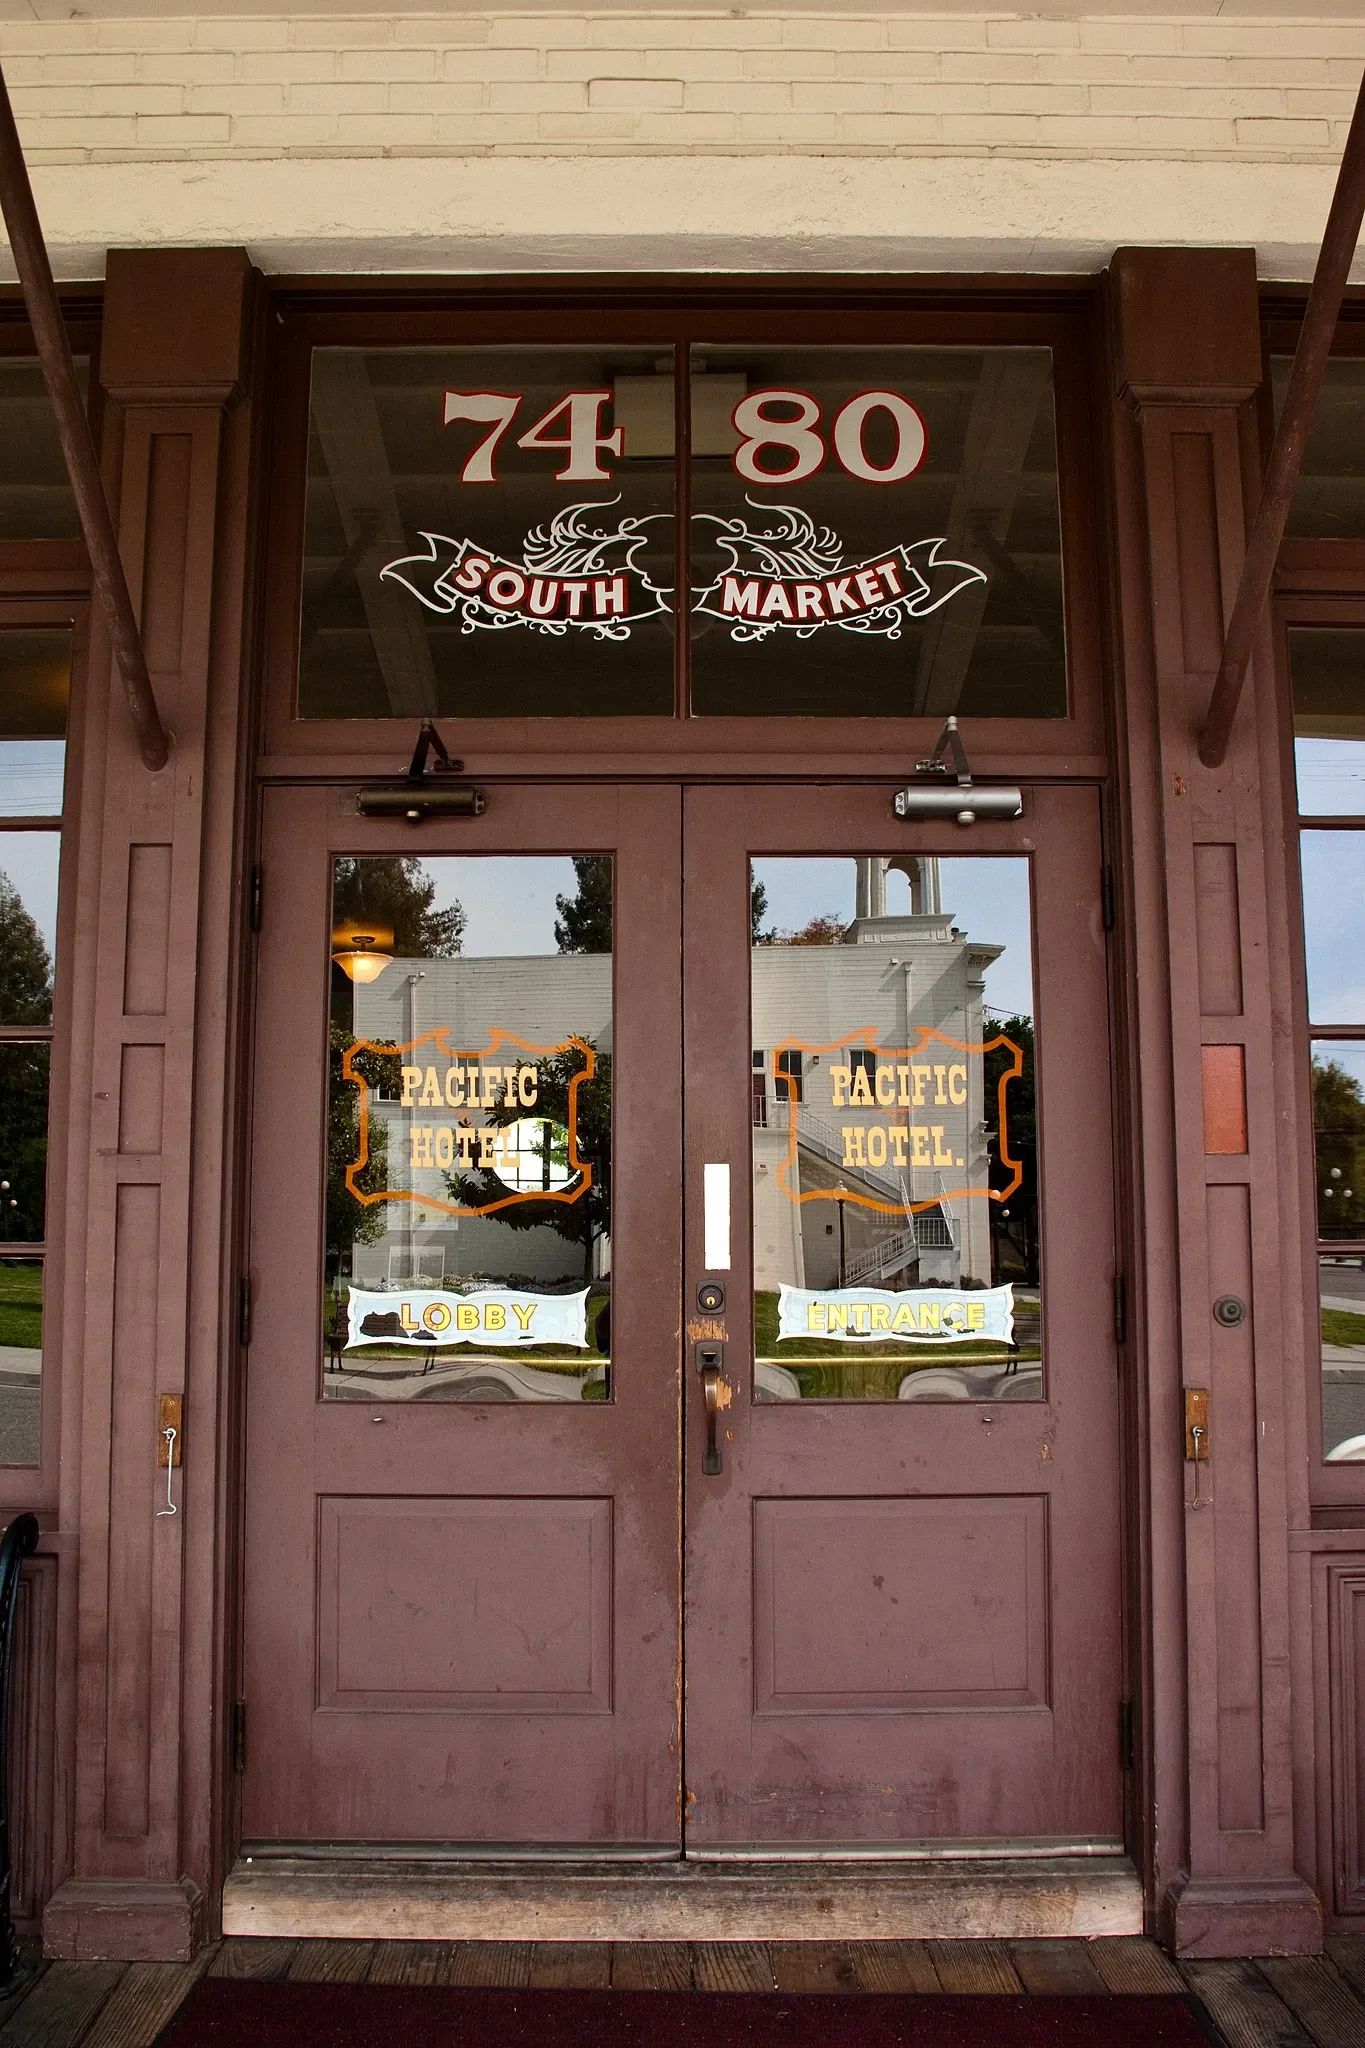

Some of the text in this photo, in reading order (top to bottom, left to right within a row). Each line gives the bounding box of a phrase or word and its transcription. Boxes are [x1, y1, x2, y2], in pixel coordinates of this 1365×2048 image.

[442, 390, 625, 484] 74
[730, 388, 930, 485] 80
[455, 557, 627, 617] SOUTH
[722, 560, 905, 620] MARKET
[400, 1066, 538, 1107] PACIFIC
[829, 1064, 967, 1106] PACIFIC
[409, 1127, 520, 1168] HOTEL
[841, 1126, 964, 1167] HOTEL.
[400, 1303, 538, 1331] LOBBY
[807, 1302, 985, 1331] ENTRANCE
